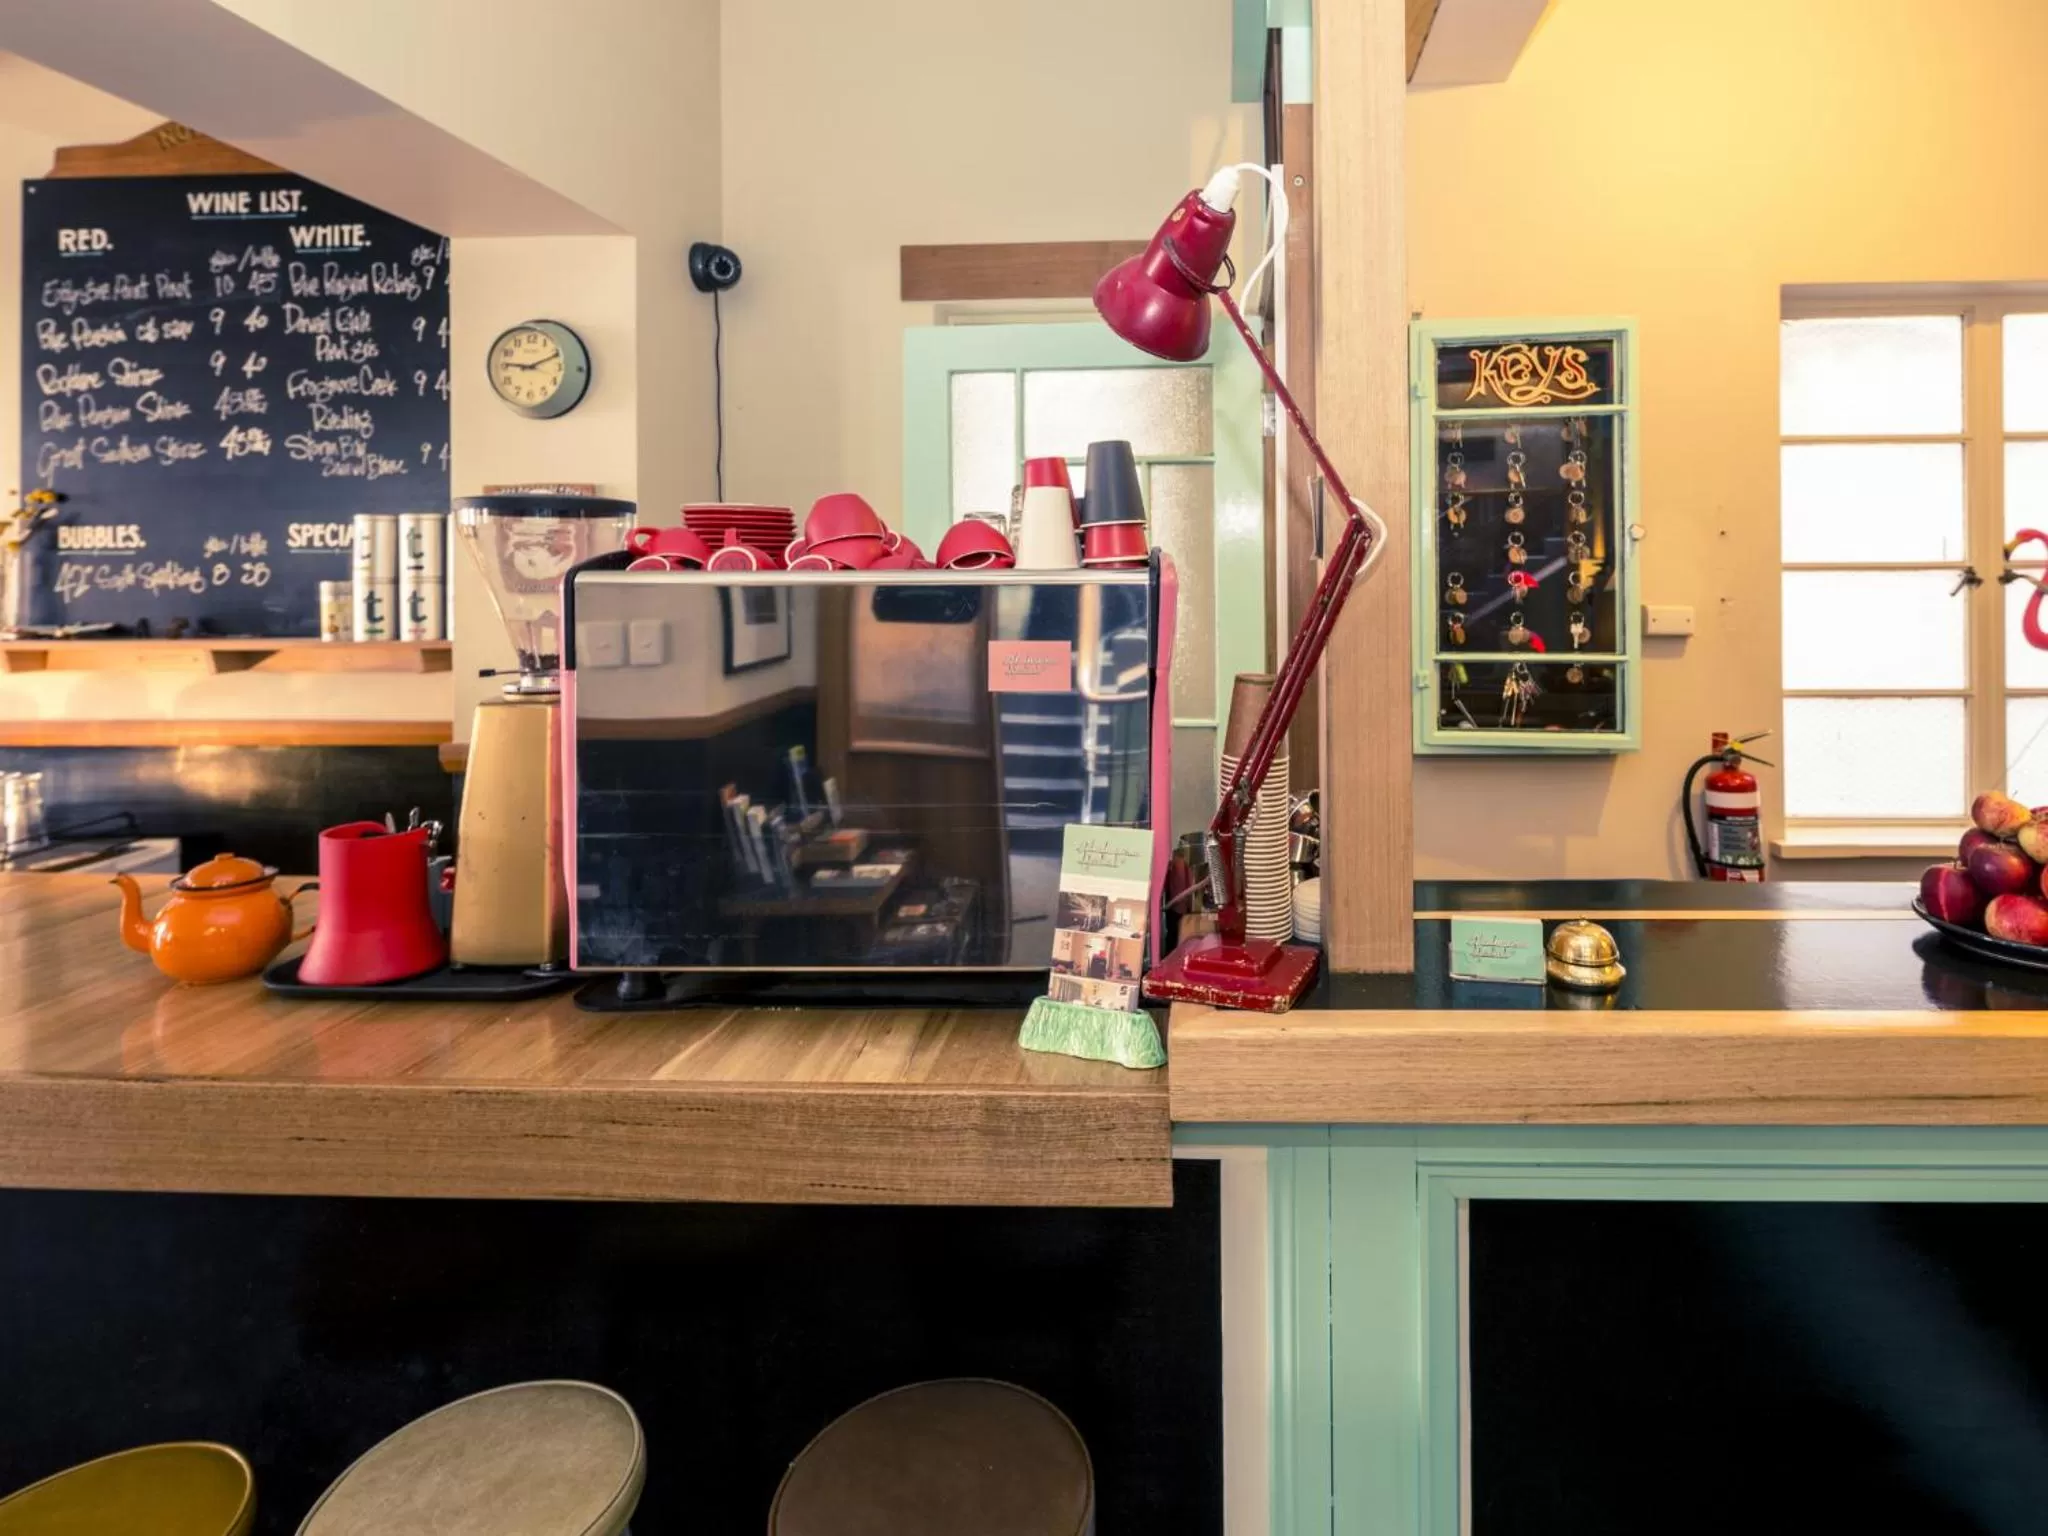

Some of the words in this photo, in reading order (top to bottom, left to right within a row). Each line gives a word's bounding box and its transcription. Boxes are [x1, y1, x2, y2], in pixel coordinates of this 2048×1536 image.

[186, 191, 252, 214] WINE
[259, 190, 309, 213] LIST.
[58, 228, 115, 251] RED.
[289, 224, 372, 248] WHITE.
[422, 265, 436, 290] 9
[208, 307, 226, 335] 9
[243, 304, 270, 333] 40
[411, 316, 427, 343] 9
[437, 316, 451, 349] 4
[208, 350, 227, 377] 9
[241, 351, 268, 380] 40
[413, 369, 428, 397] 9
[434, 368, 451, 401] 4
[419, 441, 433, 465] 9
[57, 523, 147, 549] BUBBLES.
[363, 590, 385, 624] t
[406, 589, 428, 623] t
